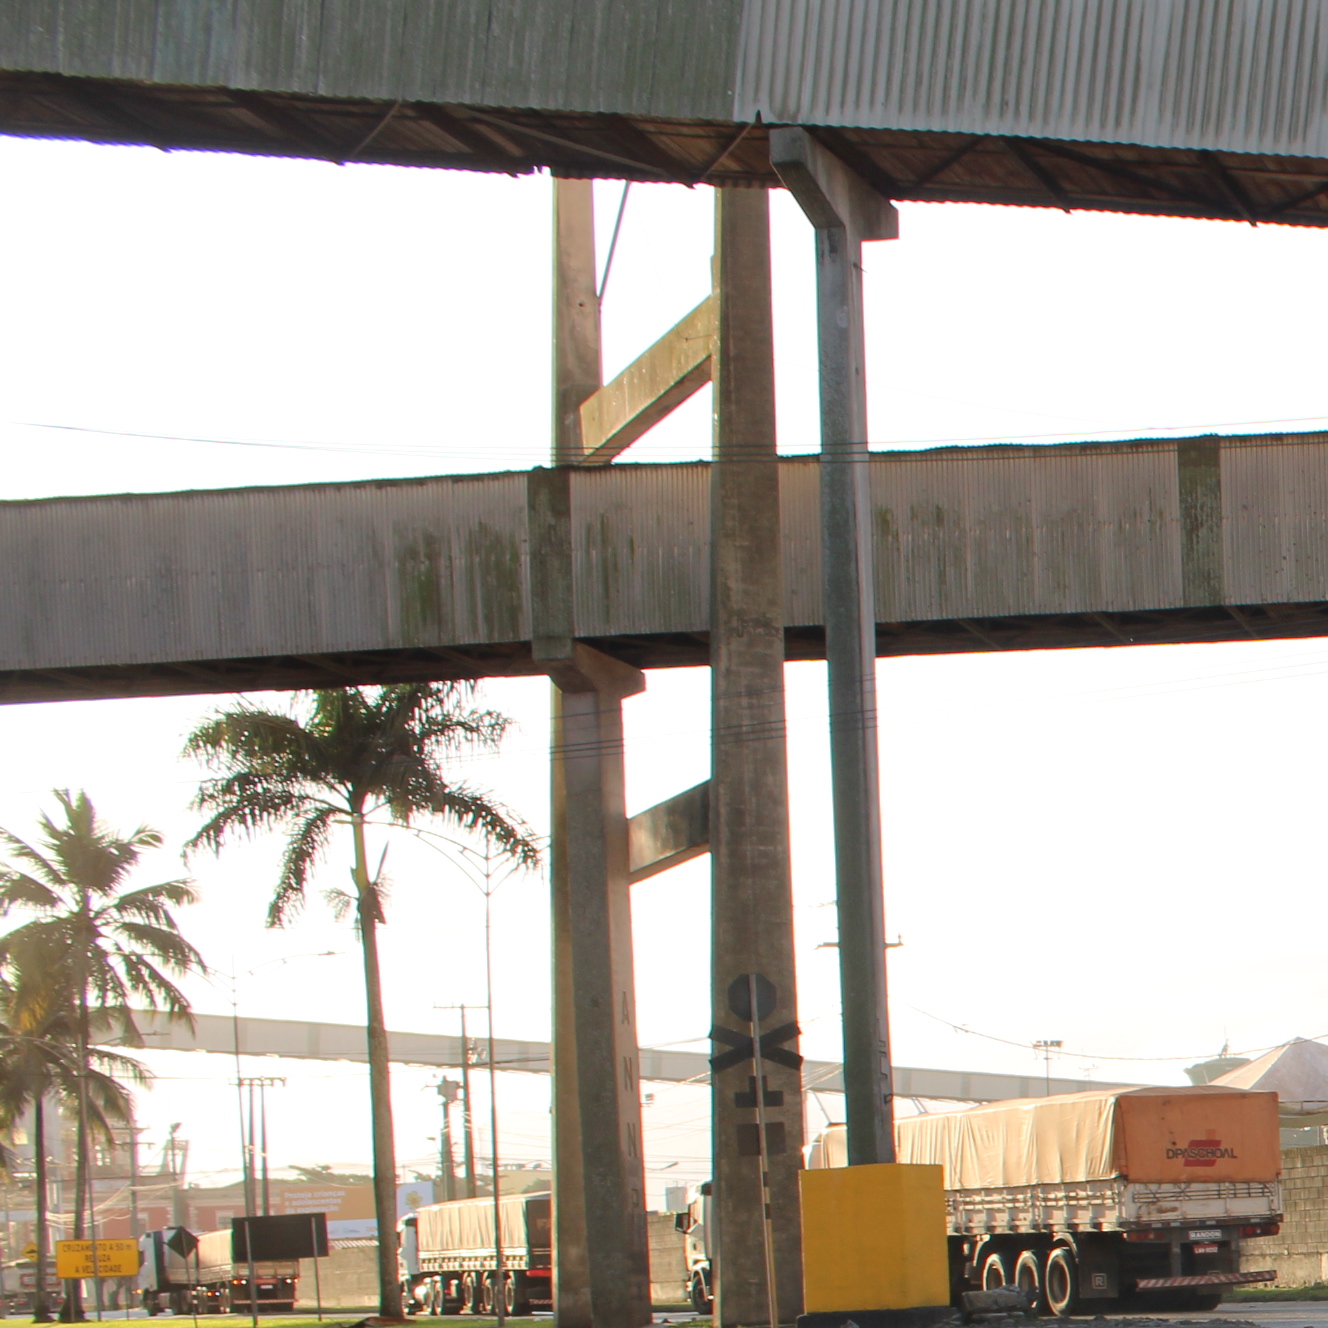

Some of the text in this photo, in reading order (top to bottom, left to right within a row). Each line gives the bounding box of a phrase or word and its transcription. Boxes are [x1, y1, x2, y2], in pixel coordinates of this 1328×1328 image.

[1166, 1147, 1237, 1159] DPASCHOAL
[1190, 1231, 1221, 1239] RANDON
[85, 1254, 110, 1262] REUZA
[82, 1265, 122, 1273] VELCIDADE
